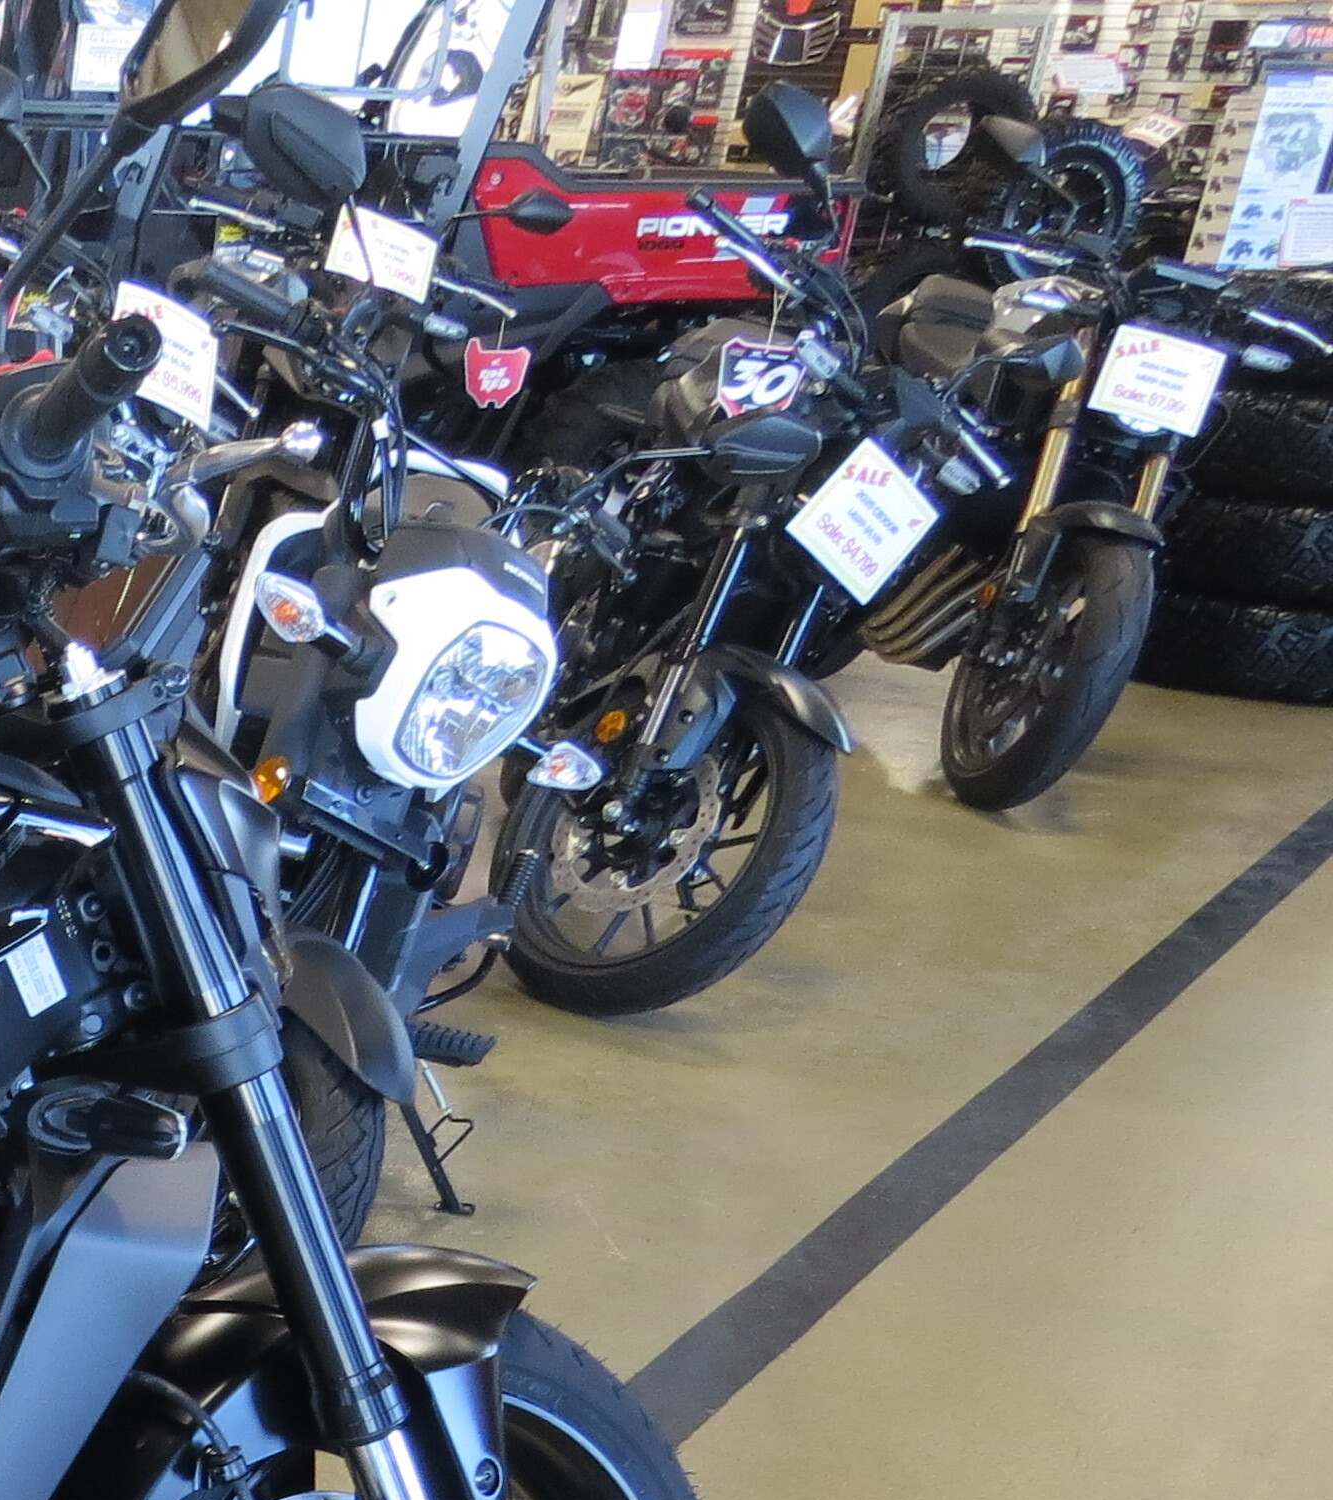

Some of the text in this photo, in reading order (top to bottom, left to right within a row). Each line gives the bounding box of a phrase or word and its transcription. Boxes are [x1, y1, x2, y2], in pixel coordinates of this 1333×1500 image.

[636, 211, 790, 238] PIONER
[1114, 339, 1162, 360] SALE
[721, 359, 800, 405] 30
[842, 463, 894, 488] SALE
